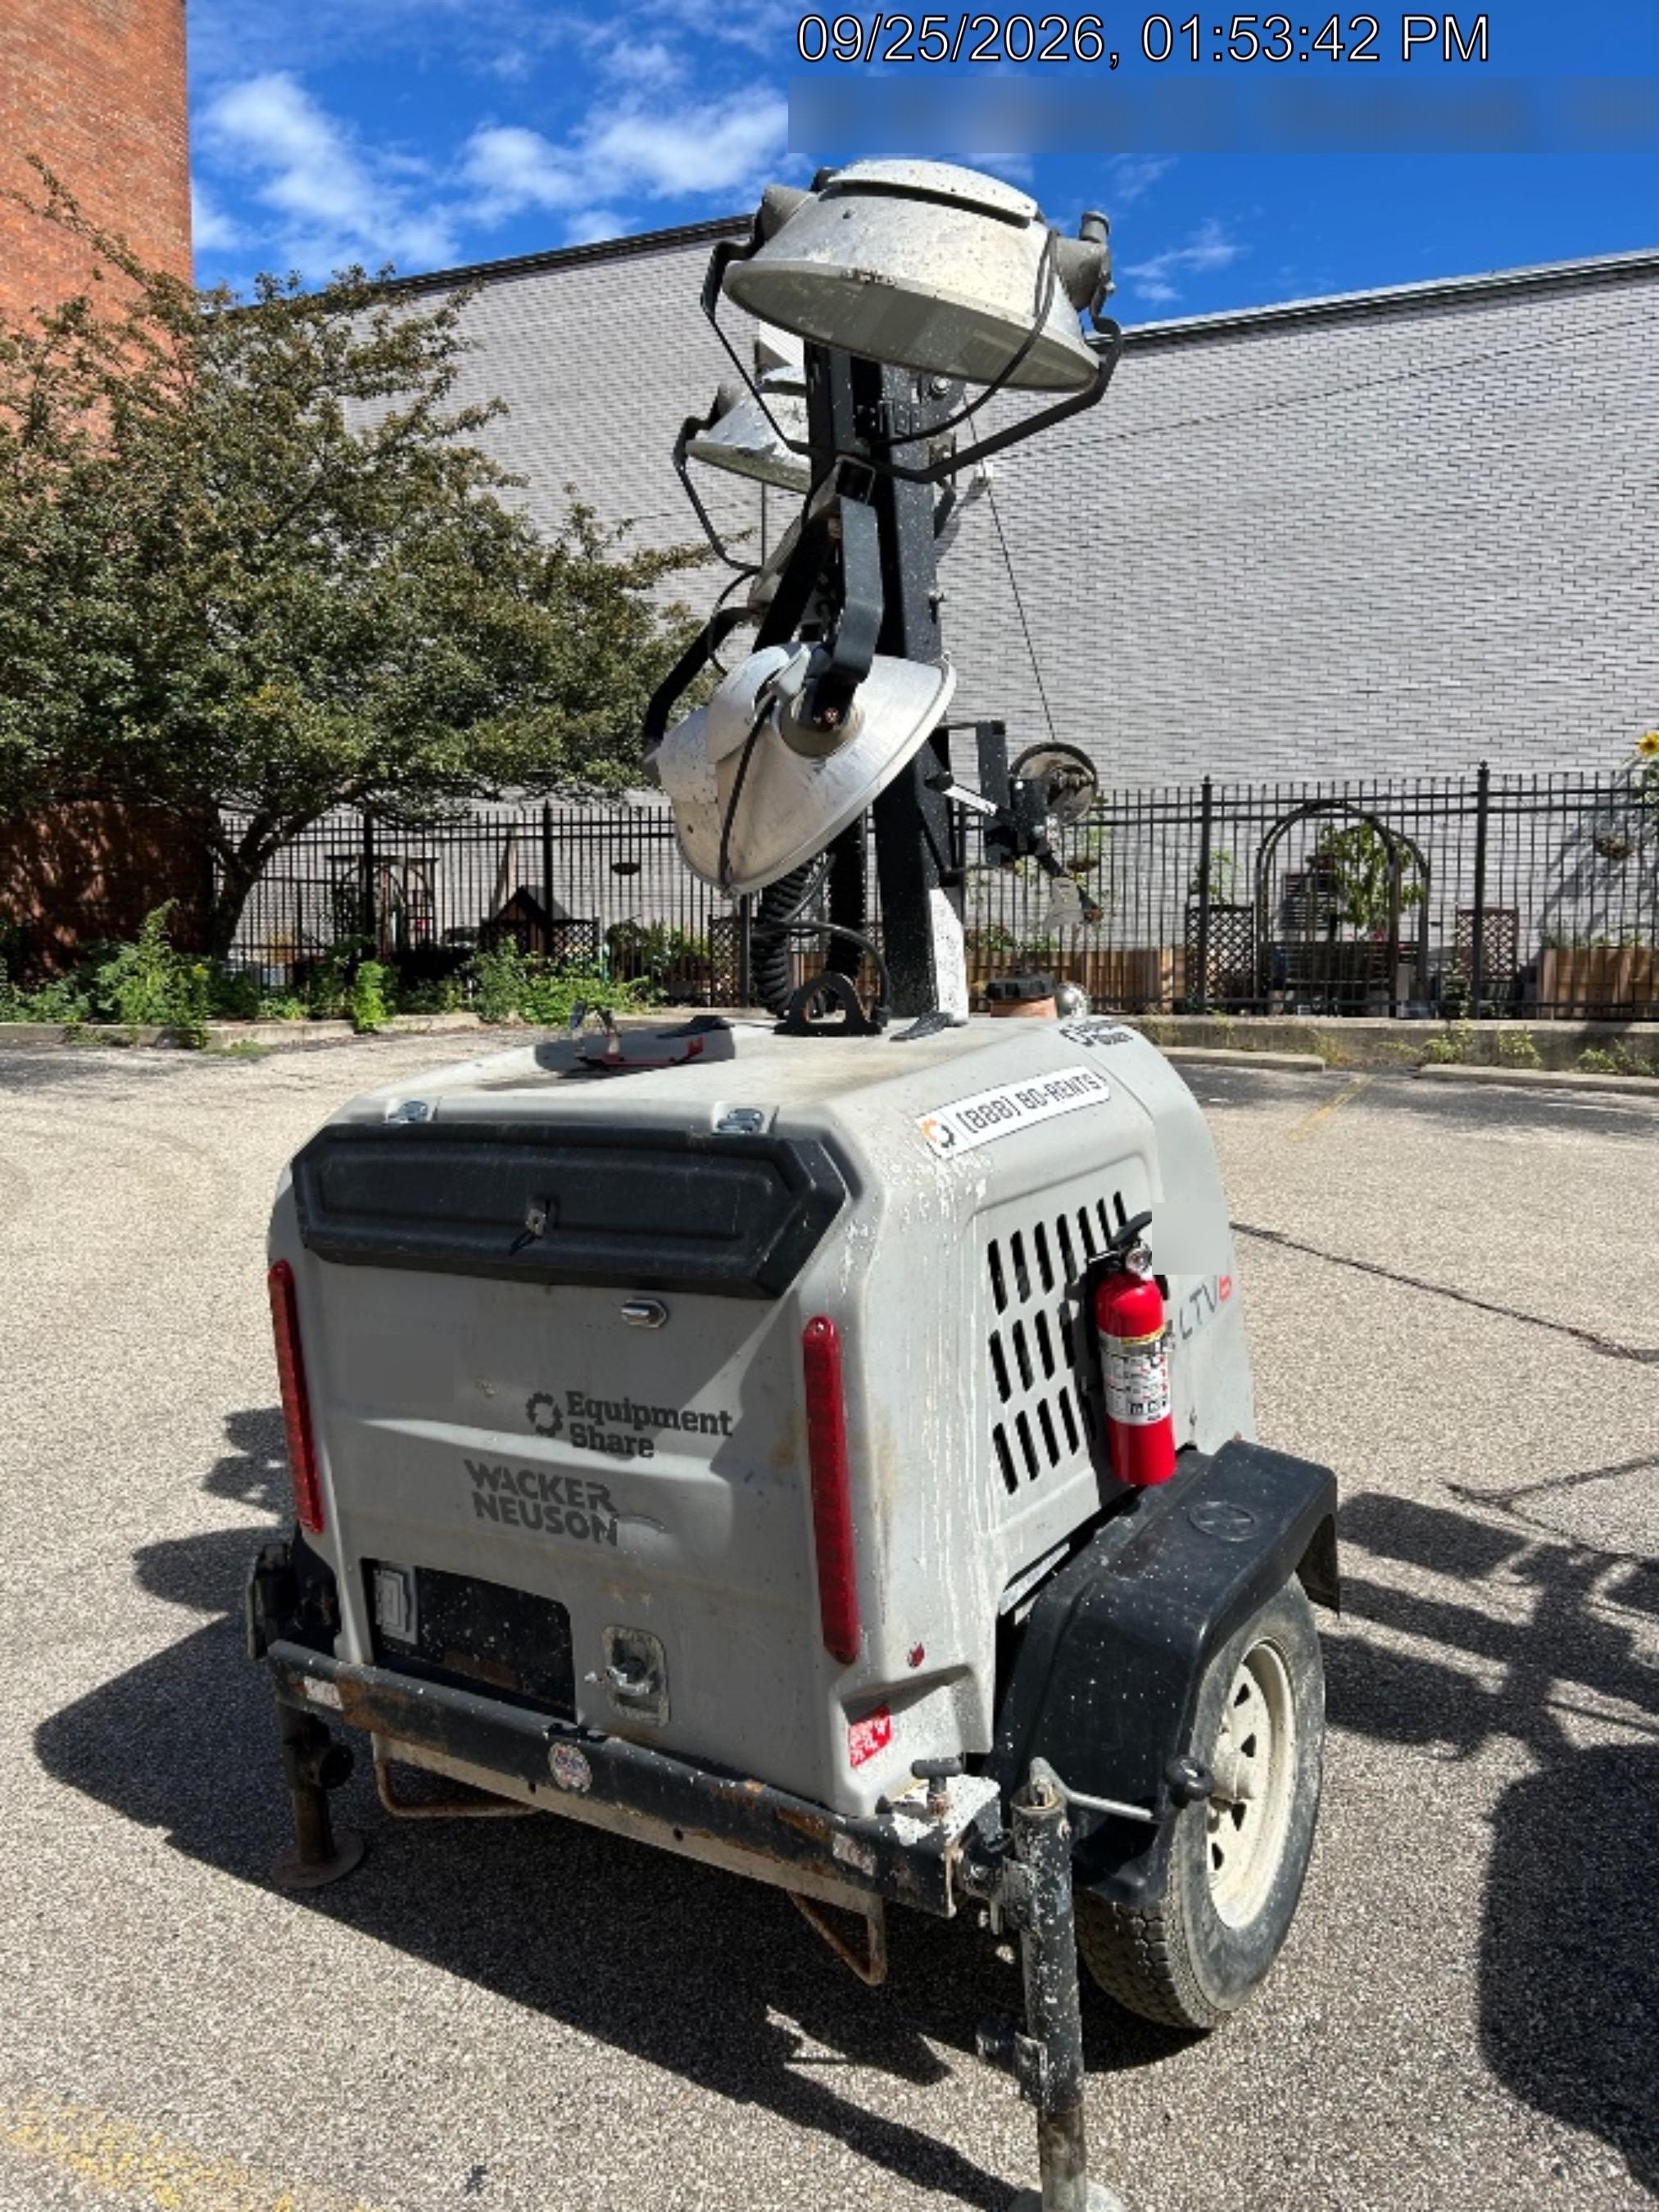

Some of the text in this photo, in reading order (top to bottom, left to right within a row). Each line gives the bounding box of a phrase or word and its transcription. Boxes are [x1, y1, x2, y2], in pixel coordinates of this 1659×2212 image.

[955, 1095, 1021, 1134] (888)
[565, 1390, 733, 1438] Equipment
[569, 1422, 655, 1458] Share
[464, 1459, 619, 1512] WACKER
[472, 1491, 618, 1547] NEUSON
